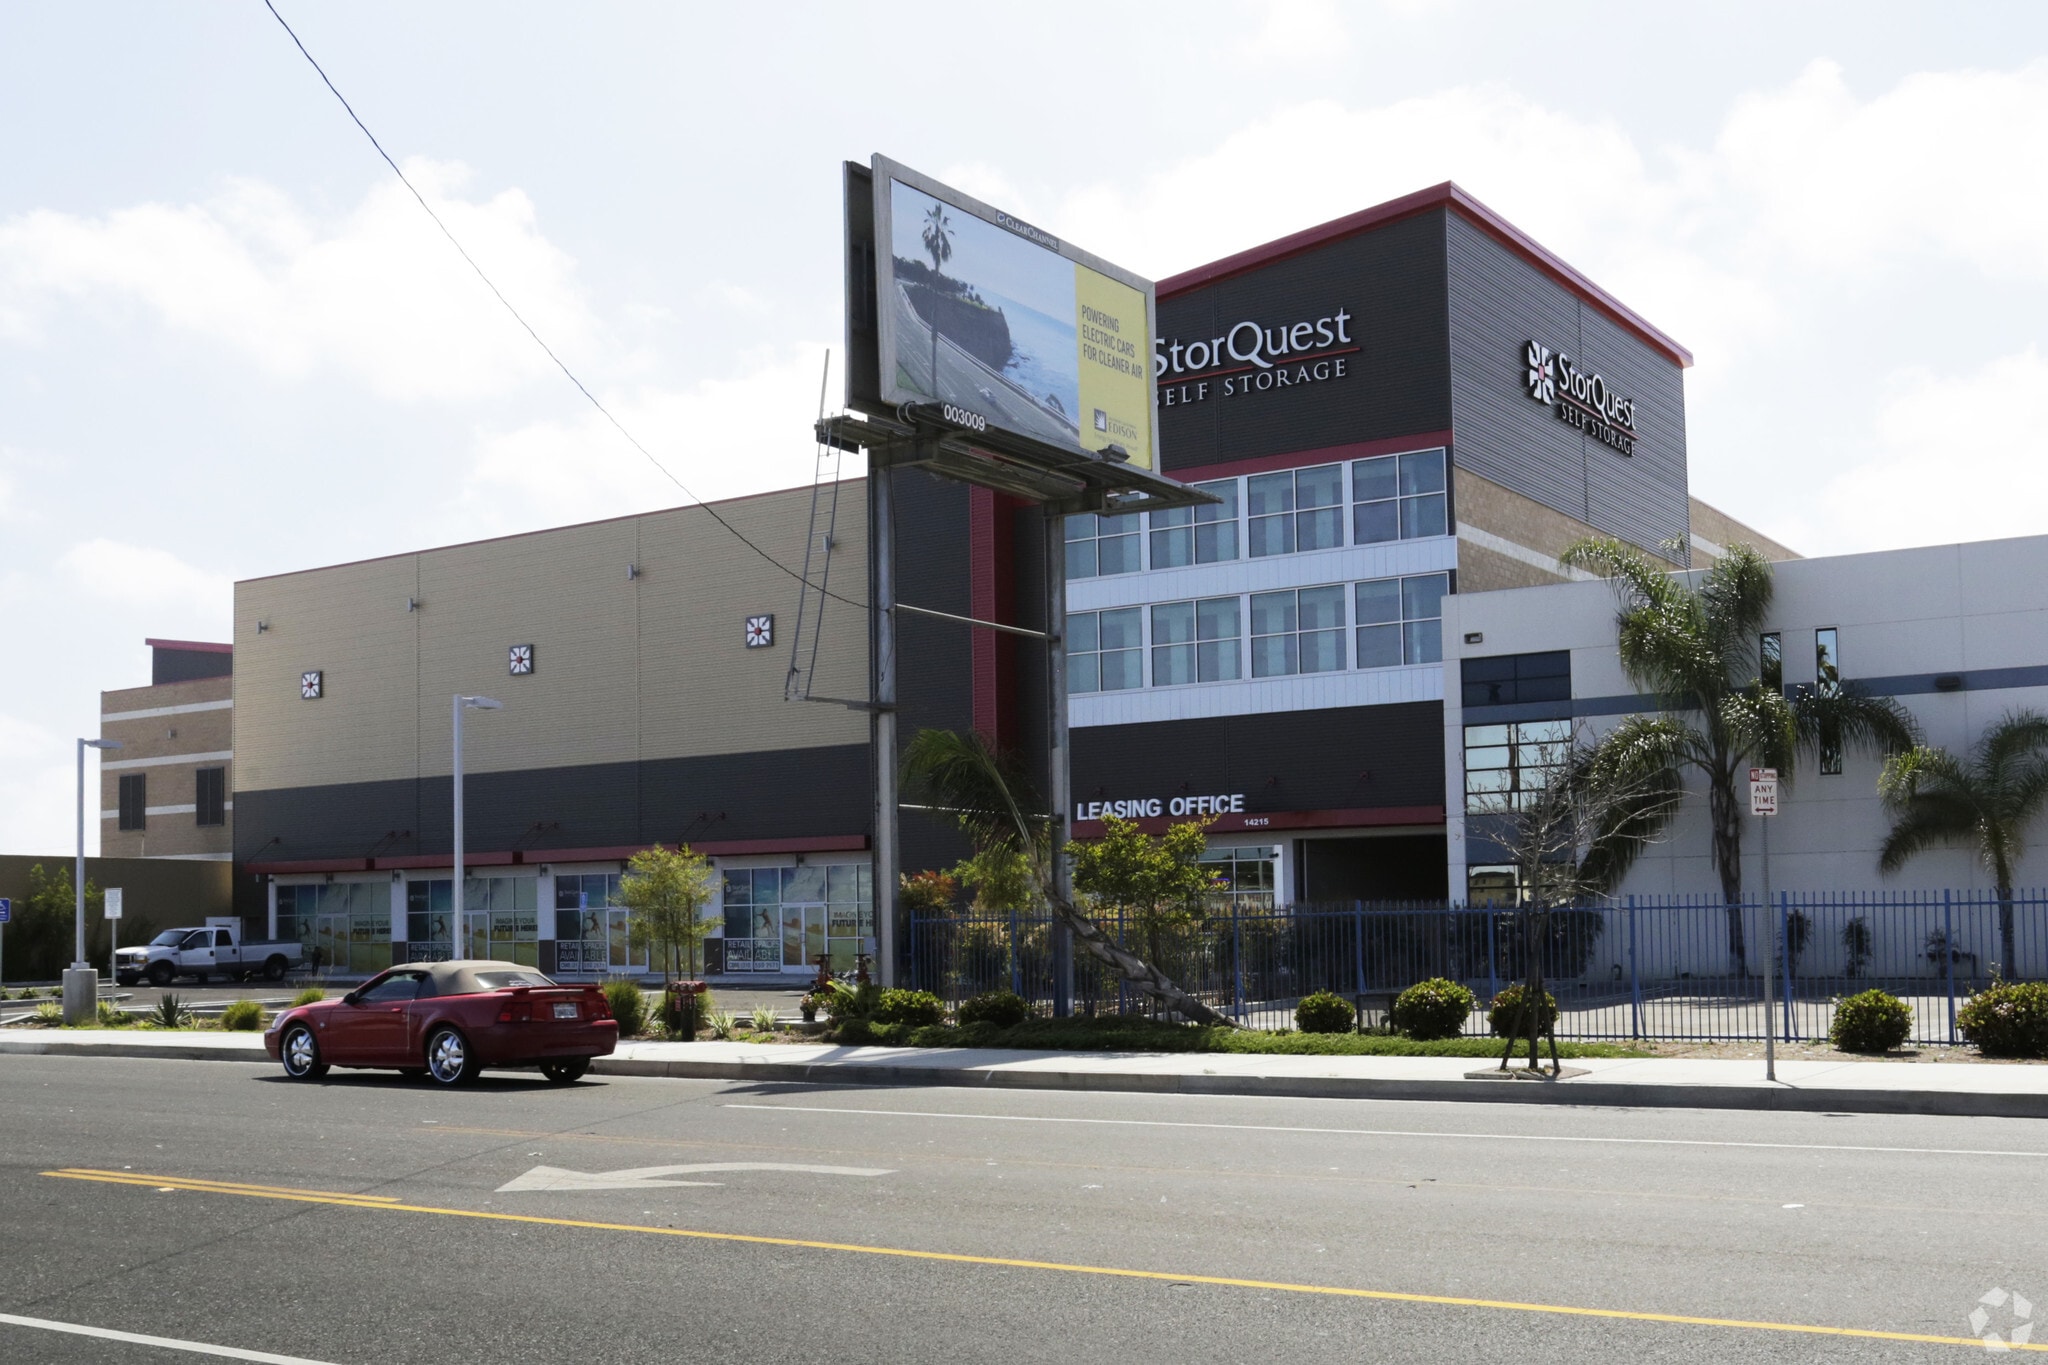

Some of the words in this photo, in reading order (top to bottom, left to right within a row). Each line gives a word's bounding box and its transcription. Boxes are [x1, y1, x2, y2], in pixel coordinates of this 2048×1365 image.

[1081, 304, 1119, 333] POWERING
[1082, 323, 1115, 351] ELECTRIC
[1116, 338, 1135, 358] CARS
[1156, 307, 1351, 377] StorQuest
[1083, 343, 1097, 361] FOR
[1098, 349, 1130, 375] CLEANER
[1131, 363, 1143, 380] AIR
[1156, 382, 1208, 407] ELF
[1224, 358, 1347, 396] STORAGE
[1559, 352, 1637, 431] StorQuest
[944, 404, 986, 432] 003009
[1562, 402, 1586, 430] SELF
[1108, 421, 1138, 441] EDISON
[1753, 796, 1775, 805] TIME
[1755, 785, 1773, 793] ANY
[1077, 798, 1163, 821] LEASING
[1169, 794, 1245, 816] OFFICE
[1244, 817, 1269, 827] 14215
